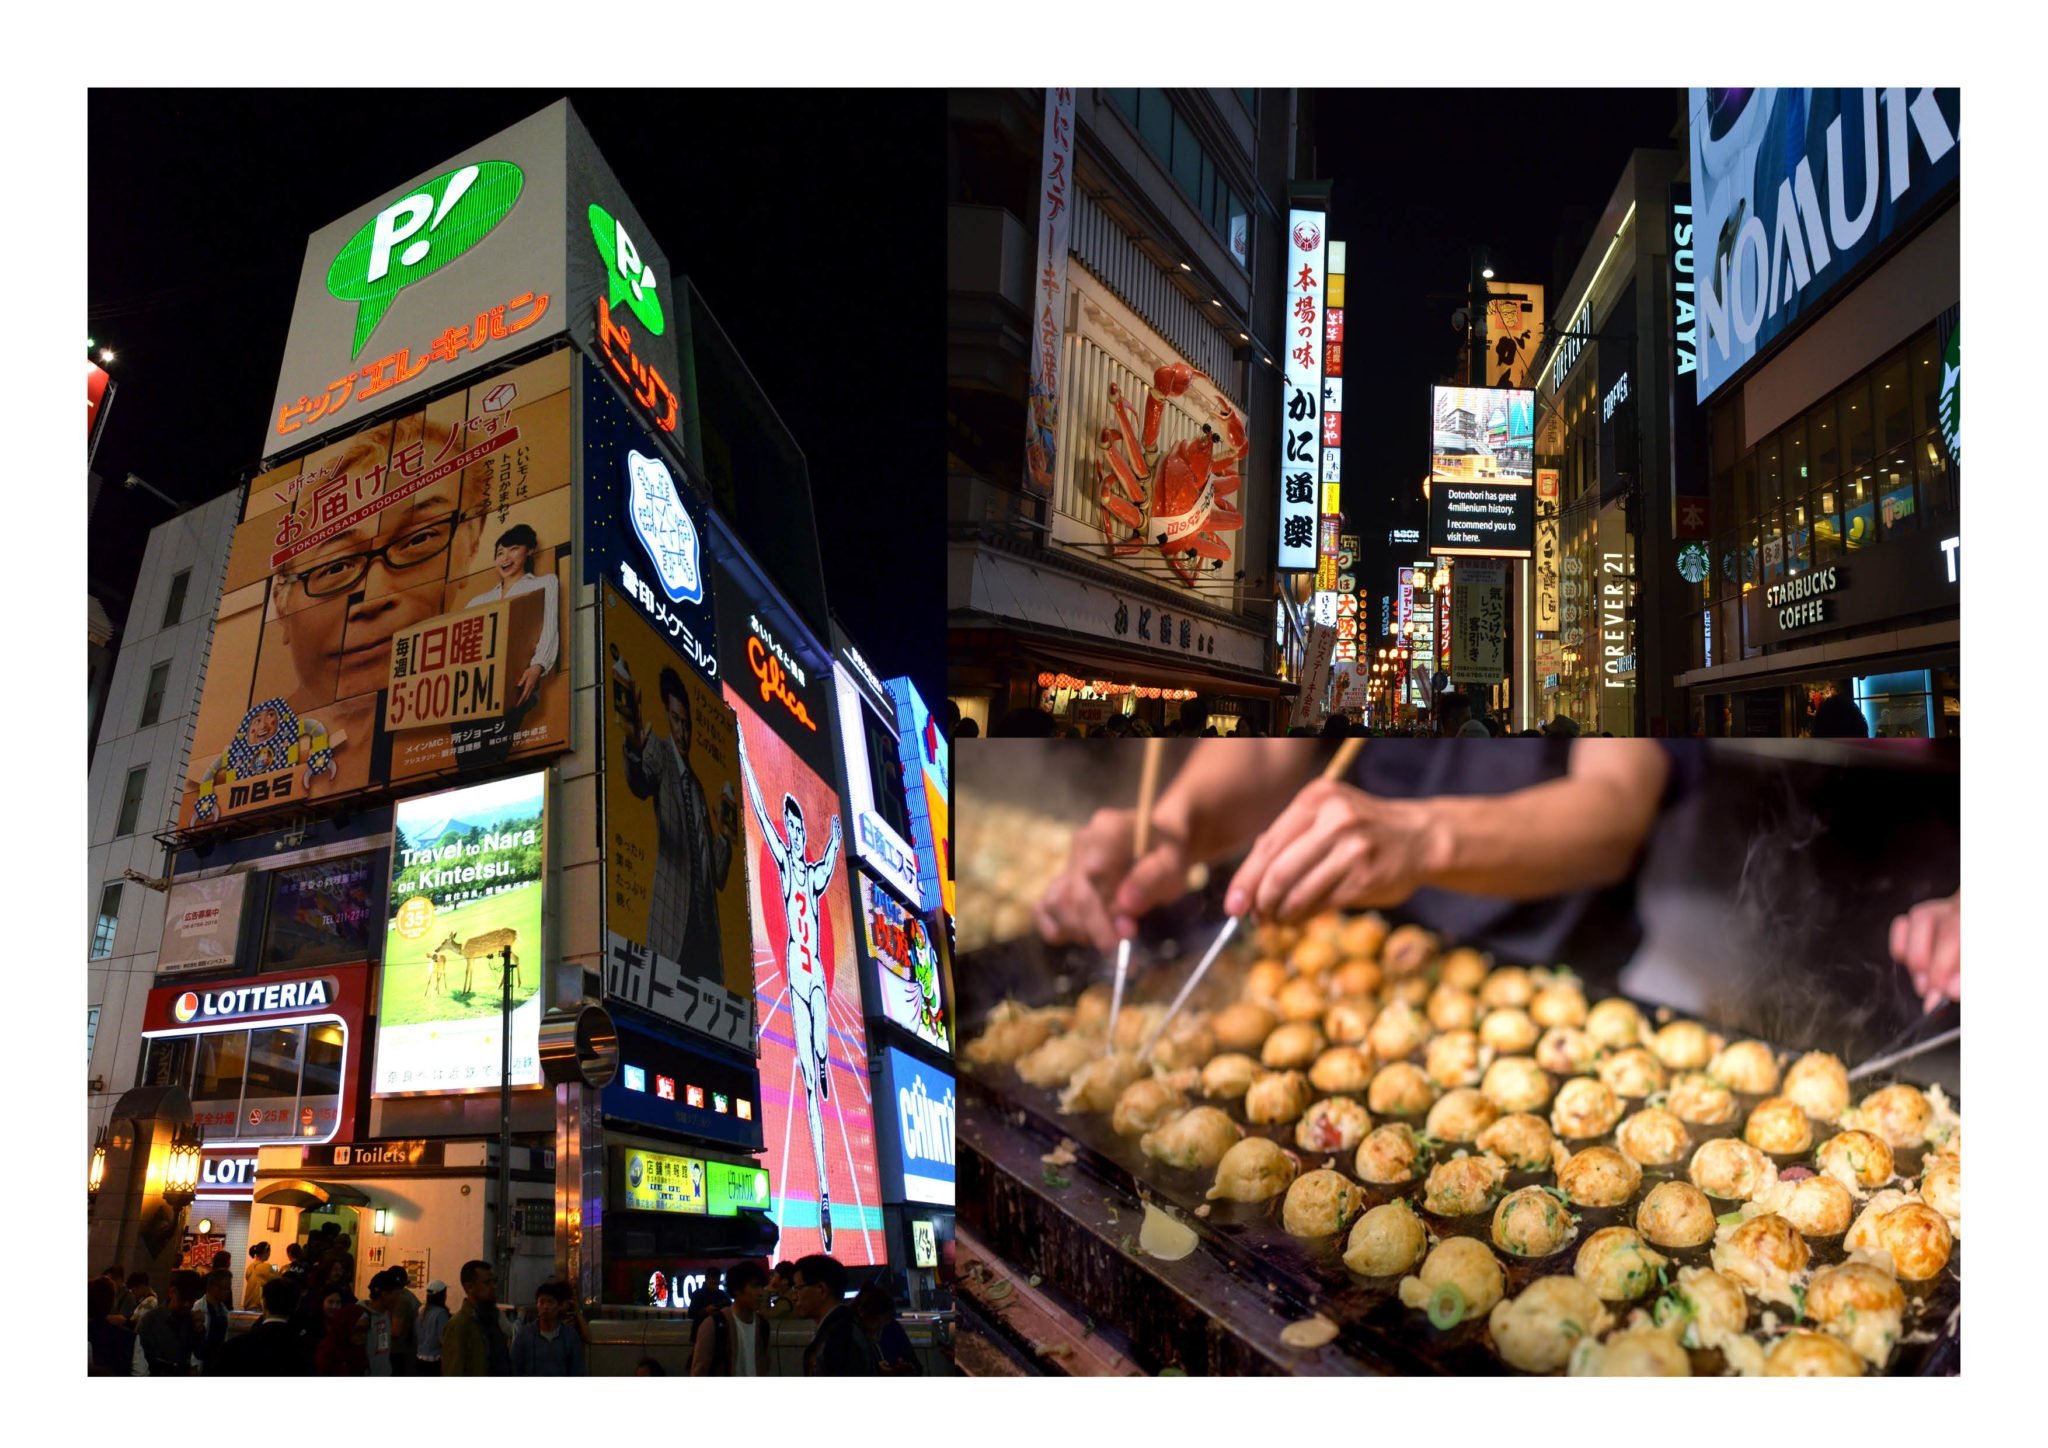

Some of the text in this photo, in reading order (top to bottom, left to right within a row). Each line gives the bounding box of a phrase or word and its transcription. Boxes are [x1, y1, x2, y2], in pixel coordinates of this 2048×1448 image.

[1292, 263, 1318, 369] 本場の味
[276, 291, 551, 435] ピップエレキバン
[289, 515, 358, 555] TOKOROSAN
[361, 465, 452, 517] OTODOKEMONO
[1448, 490, 1517, 502] Dotonbori has great
[1448, 503, 1514, 514] 4millenium history.
[1447, 532, 1480, 542] visit here.
[1451, 520, 1493, 530] recommend
[1493, 522, 1508, 532] you
[1508, 522, 1516, 531] to
[1766, 566, 1837, 609] STARBUCKS
[1779, 599, 1825, 631] COFFEE
[1604, 583, 1625, 688] FOREVER
[393, 637, 410, 679] 毎週
[747, 635, 817, 732] Glico
[401, 828, 536, 868] Travel to Nara
[397, 859, 516, 894] on Kintetsu.
[795, 890, 813, 974] グリコ
[203, 979, 327, 1016] LOTTERIA
[354, 1149, 406, 1164] Toilets
